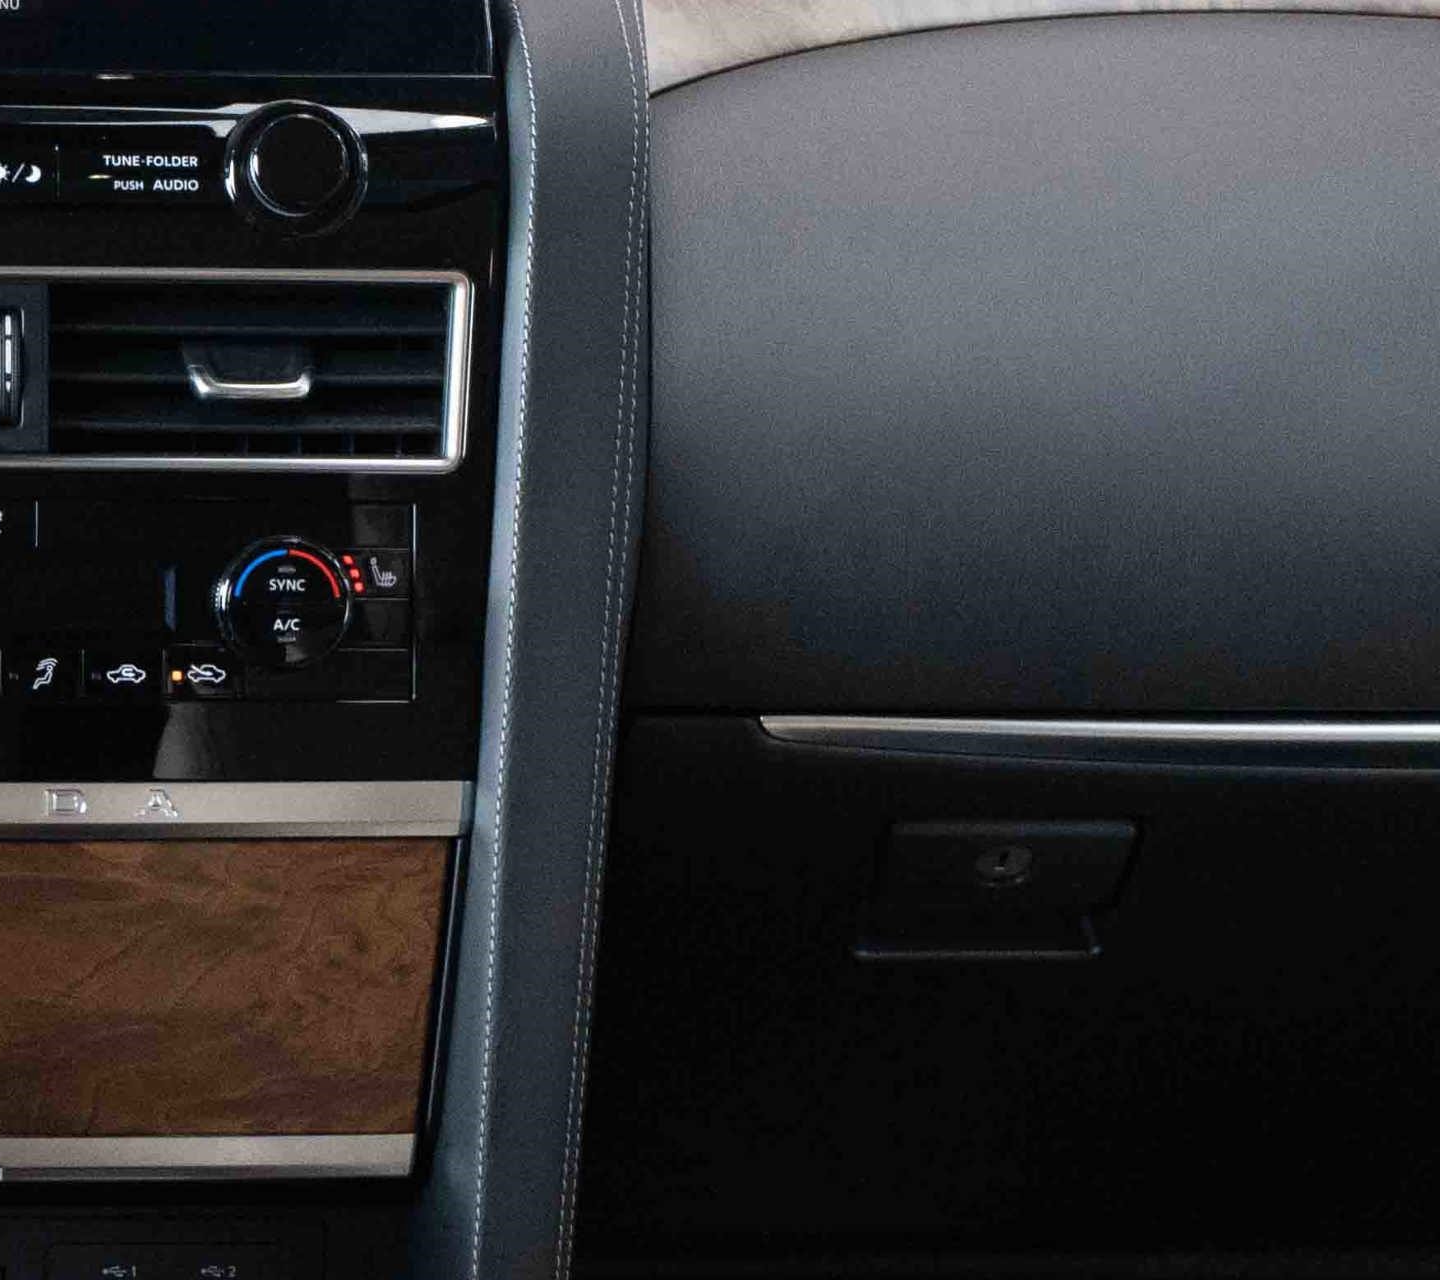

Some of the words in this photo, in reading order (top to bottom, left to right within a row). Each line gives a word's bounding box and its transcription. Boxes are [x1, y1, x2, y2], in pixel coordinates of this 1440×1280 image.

[113, 179, 144, 191] PUSH
[152, 178, 200, 191] AUDIO
[269, 579, 306, 591] SYNC
[273, 618, 301, 631] A/C
